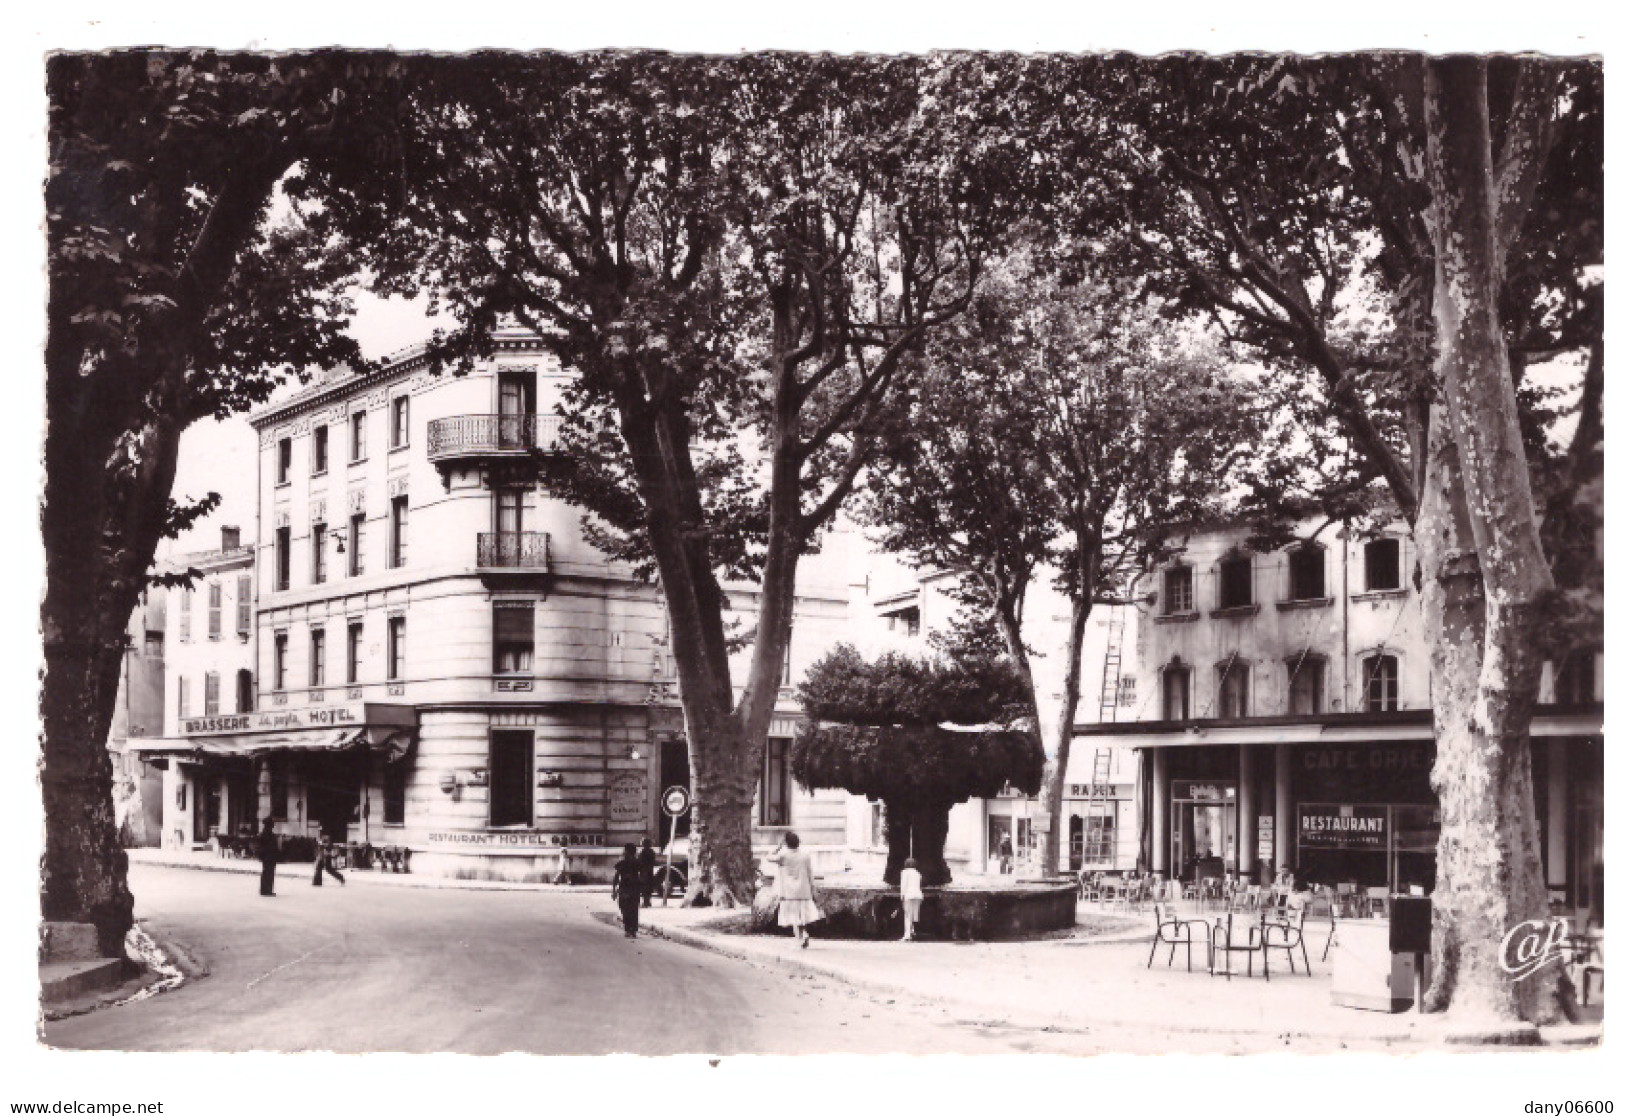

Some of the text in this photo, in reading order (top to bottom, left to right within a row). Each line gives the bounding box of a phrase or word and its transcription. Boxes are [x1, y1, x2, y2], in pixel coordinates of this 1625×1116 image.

[186, 716, 251, 732] BRASSERIE
[310, 708, 356, 725] HOTEL
[1302, 815, 1384, 833] RESTAURANT
[428, 832, 496, 845] RESTAURANT
[499, 833, 547, 846] HOTEL
